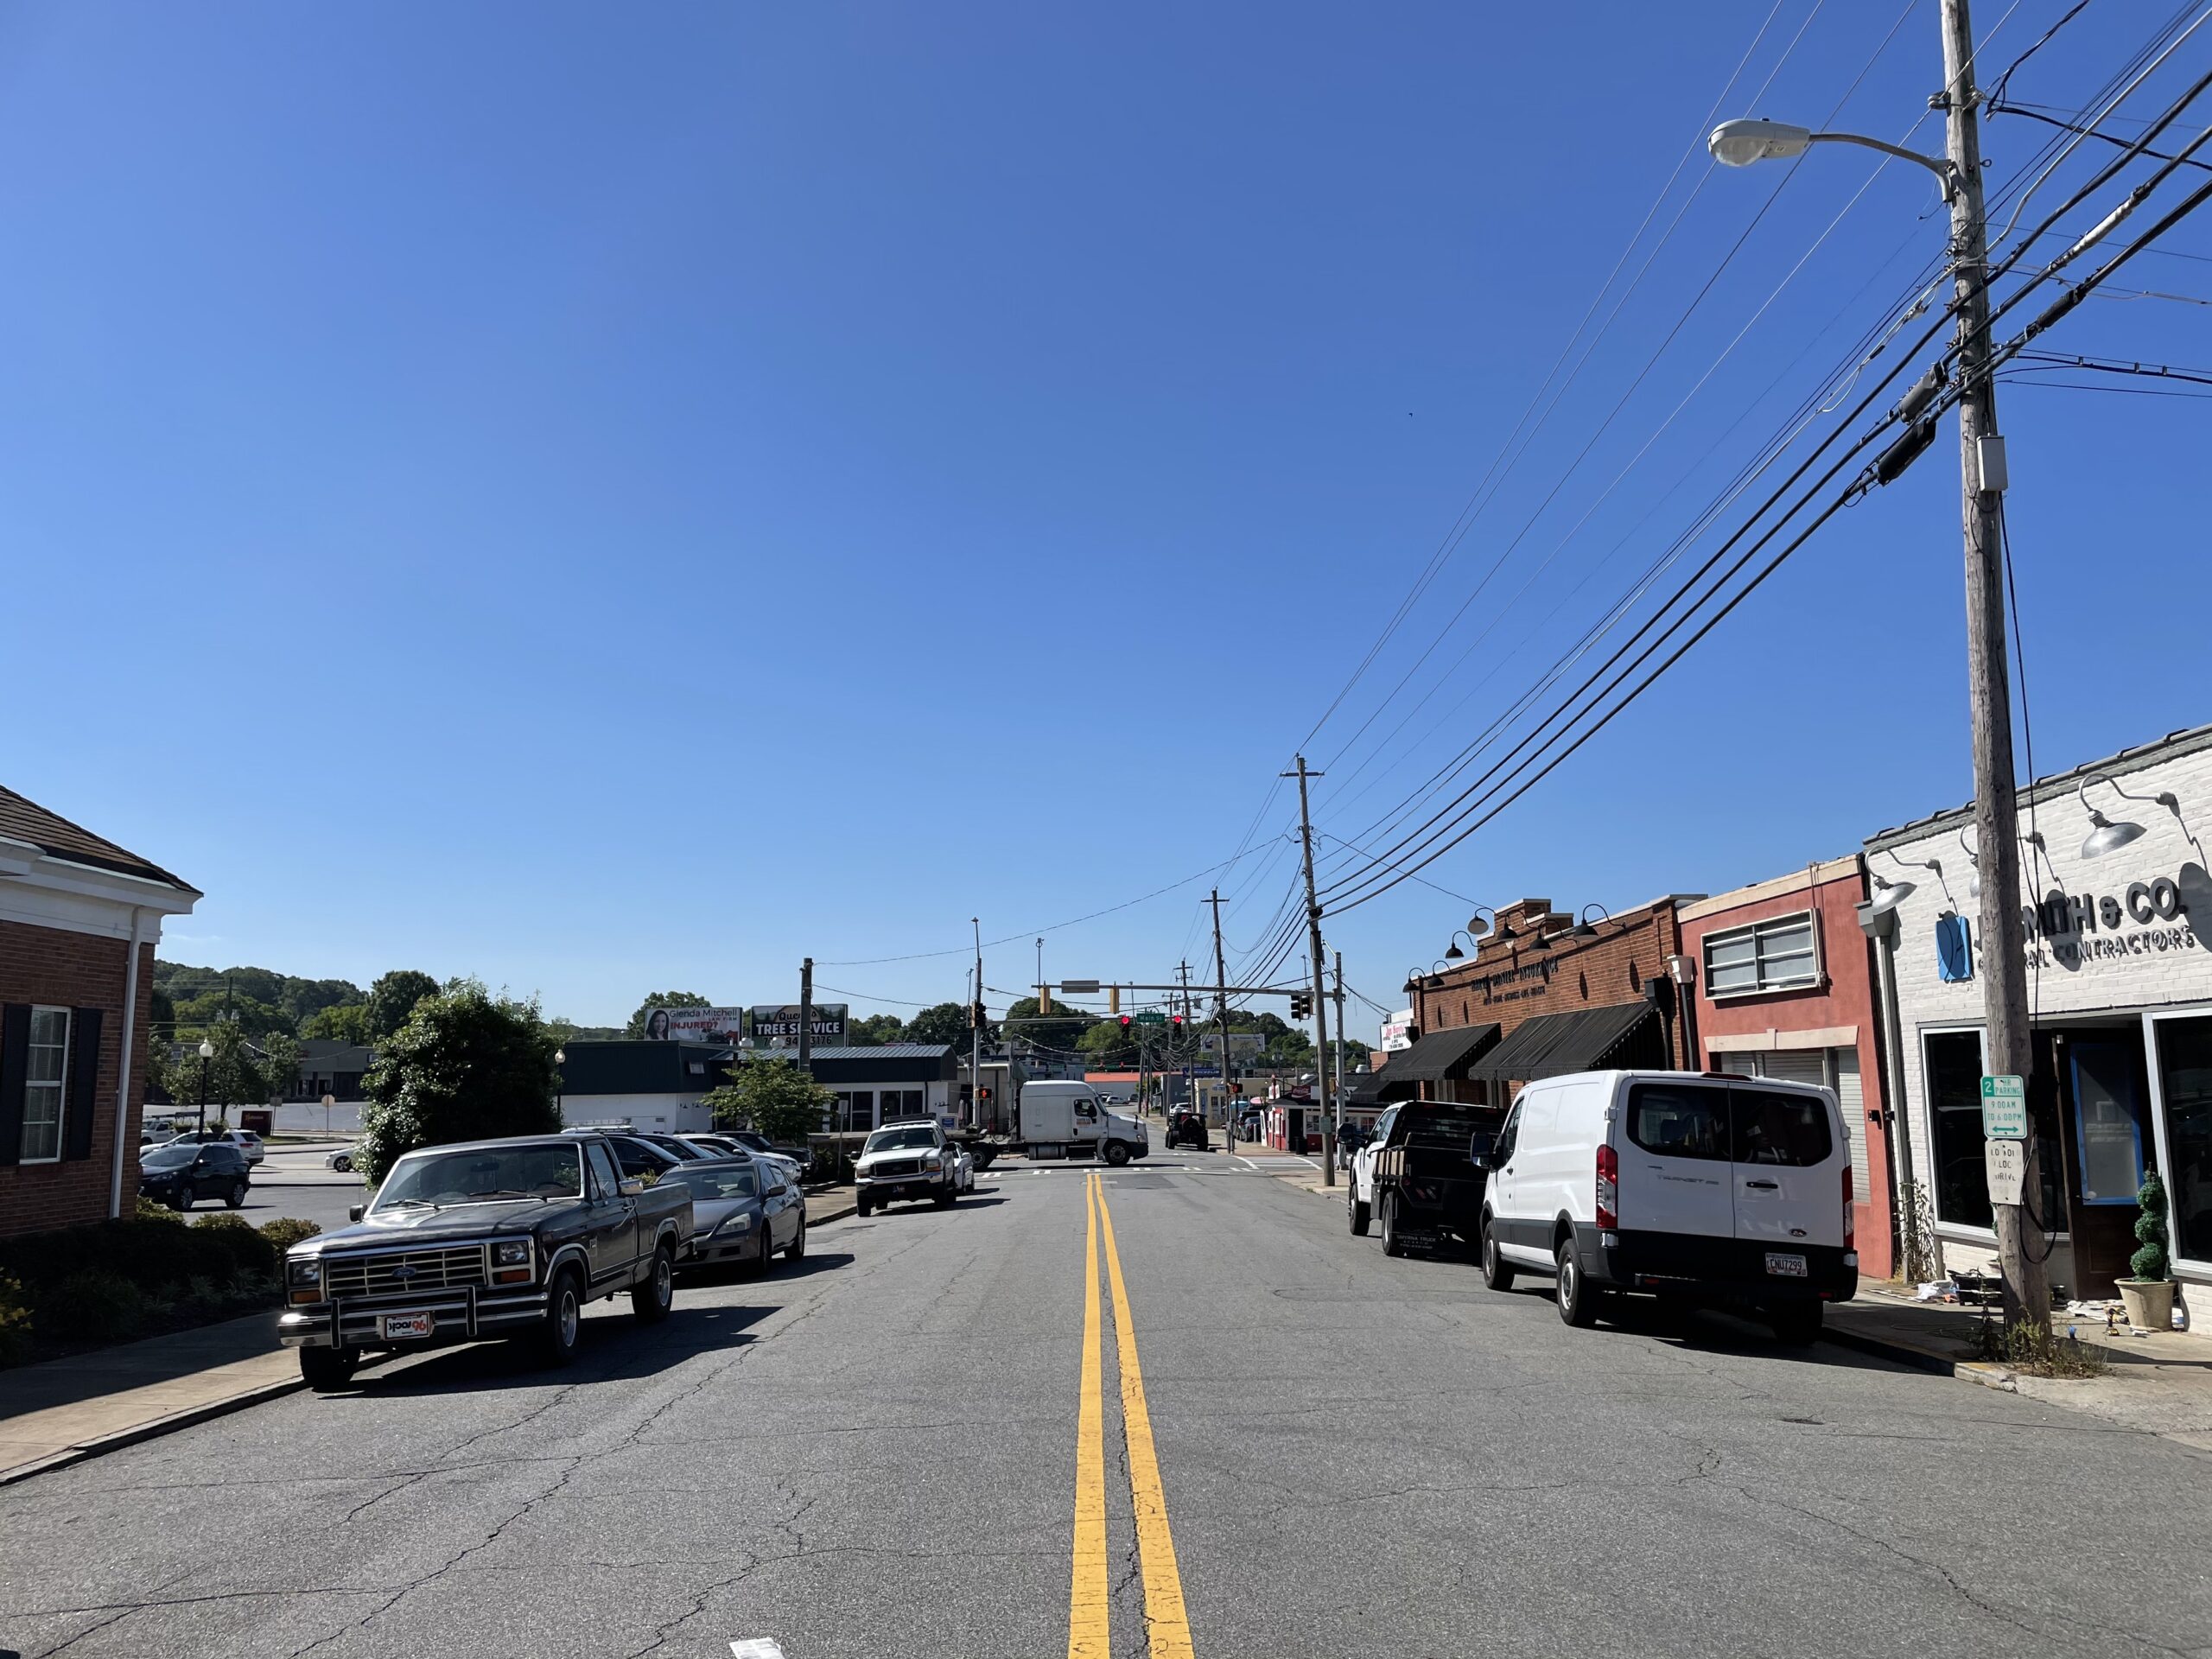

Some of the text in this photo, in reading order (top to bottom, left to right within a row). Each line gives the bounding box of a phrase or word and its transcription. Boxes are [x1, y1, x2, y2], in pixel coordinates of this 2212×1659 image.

[2099, 895, 2120, 929] &
[2054, 925, 2195, 962] CONTRACTORS
[669, 1008, 737, 1018] Glenda Mitchell
[670, 1020, 719, 1030] INJURED?
[756, 1021, 840, 1035] TREE SVICE
[1985, 1081, 1993, 1093] 2
[1995, 1086, 2022, 1096] PARKING
[1770, 1258, 1802, 1271] CNU7299
